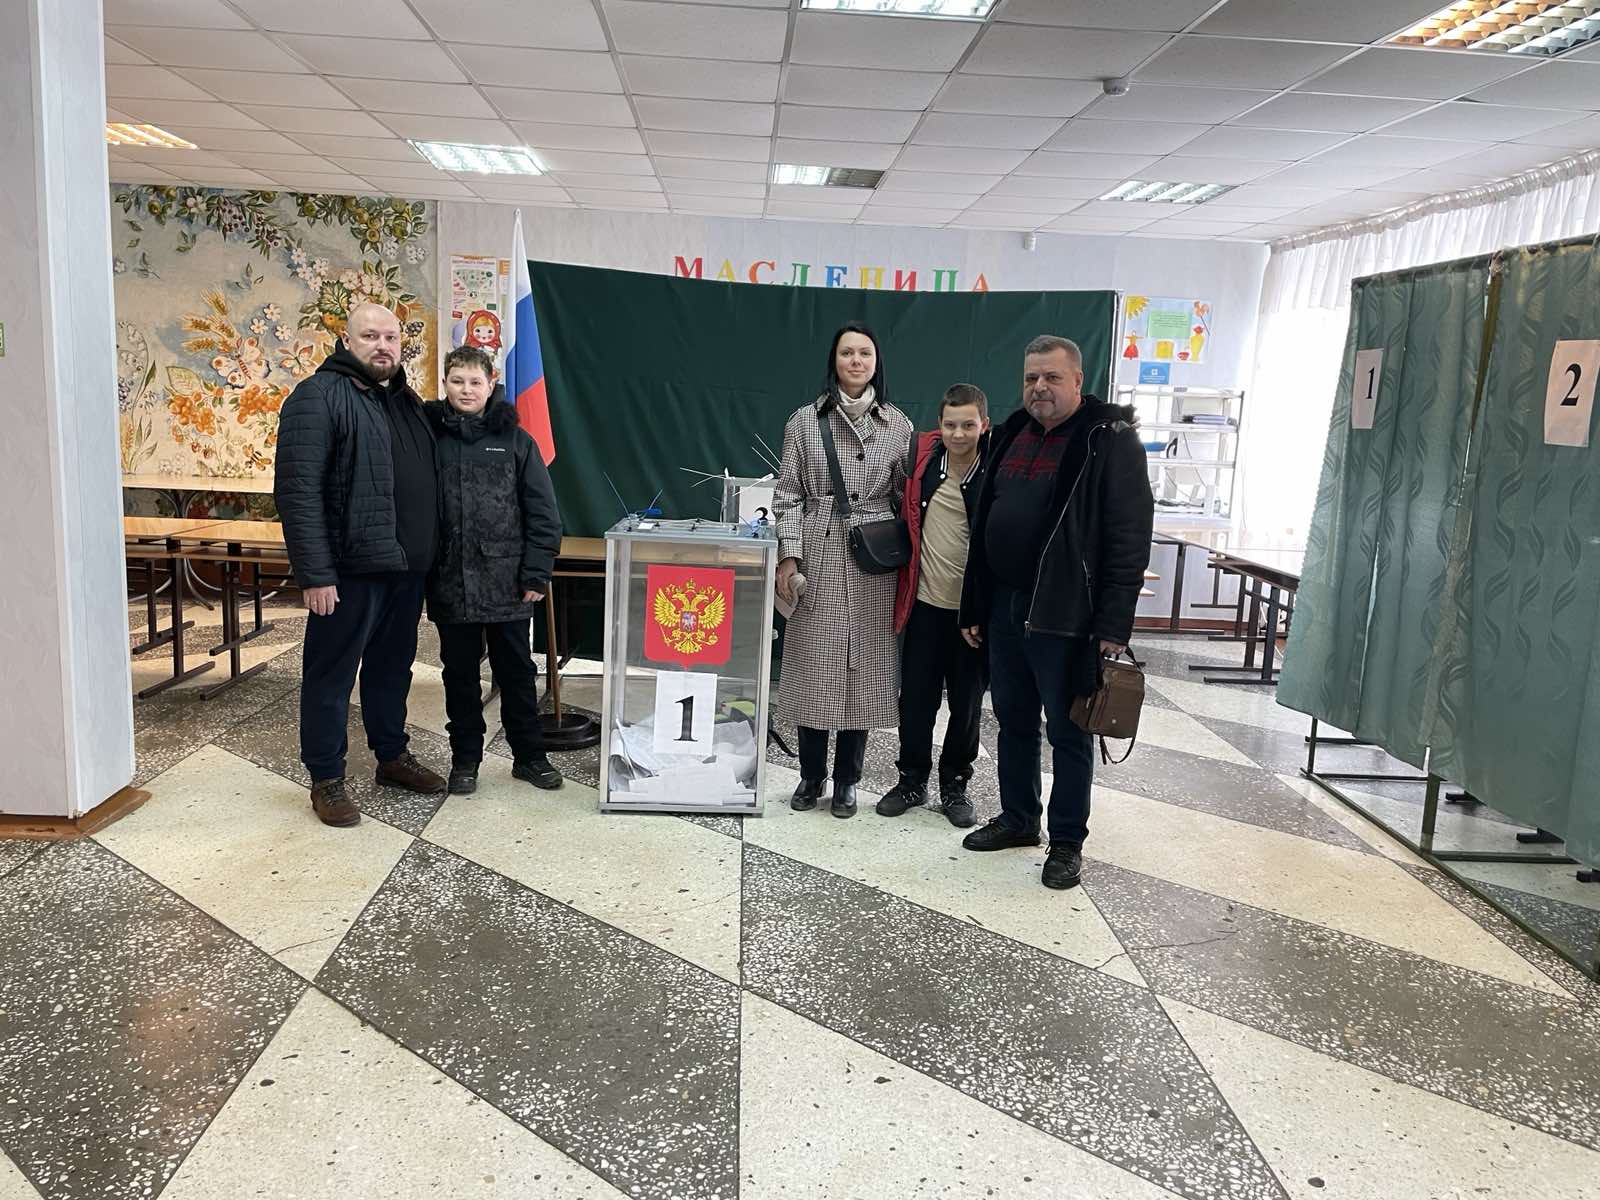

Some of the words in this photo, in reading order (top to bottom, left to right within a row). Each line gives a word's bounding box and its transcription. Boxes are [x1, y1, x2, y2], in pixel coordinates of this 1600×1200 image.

[1365, 366, 1376, 400] 1
[1560, 363, 1582, 407] 2
[673, 695, 699, 742] 1
